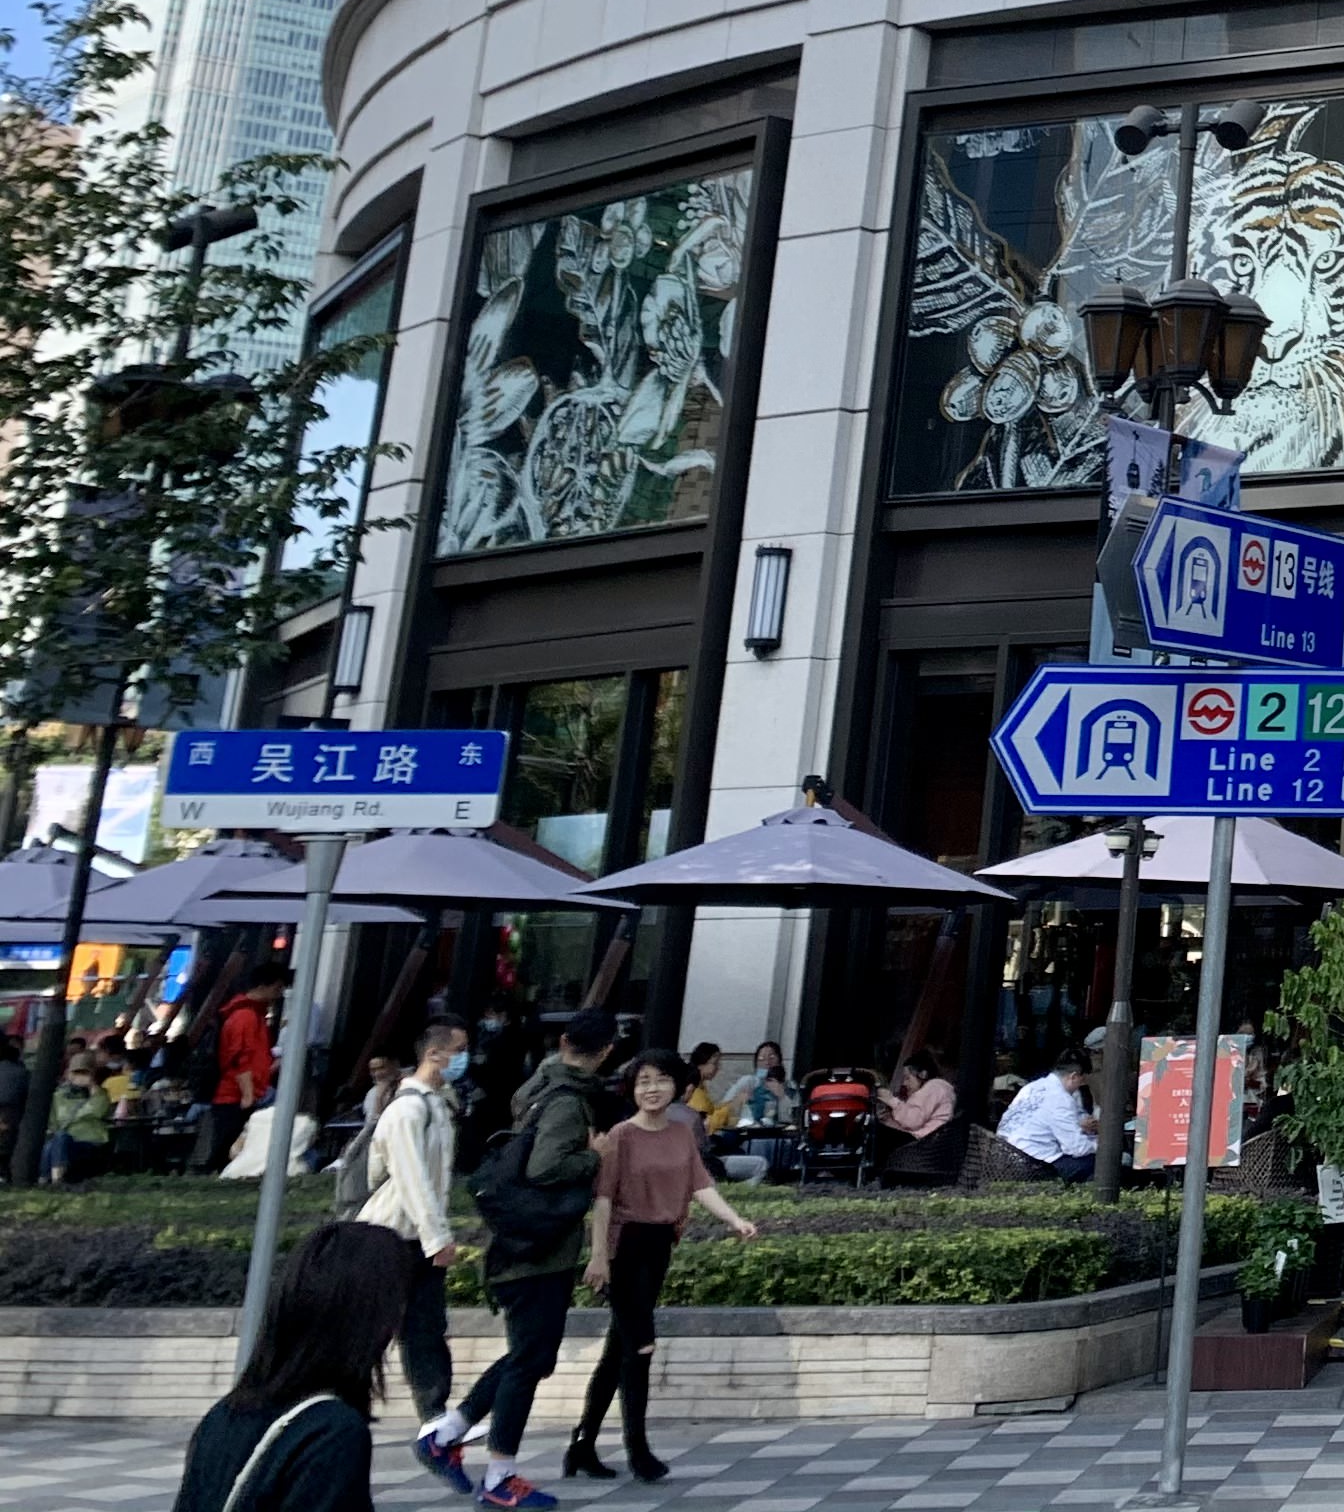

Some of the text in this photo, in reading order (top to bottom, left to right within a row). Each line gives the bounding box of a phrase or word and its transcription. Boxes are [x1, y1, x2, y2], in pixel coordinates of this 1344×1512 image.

[1275, 551, 1335, 599] 13 号线
[1261, 624, 1316, 653] Line 13
[1257, 692, 1287, 733] 2
[189, 742, 483, 785] 西 吴江路 东
[1209, 747, 1276, 771] Line
[1303, 749, 1321, 771] 2
[1207, 777, 1273, 801] Line
[1292, 777, 1324, 802] 12
[180, 801, 471, 820] W Wujiang Rd. E
